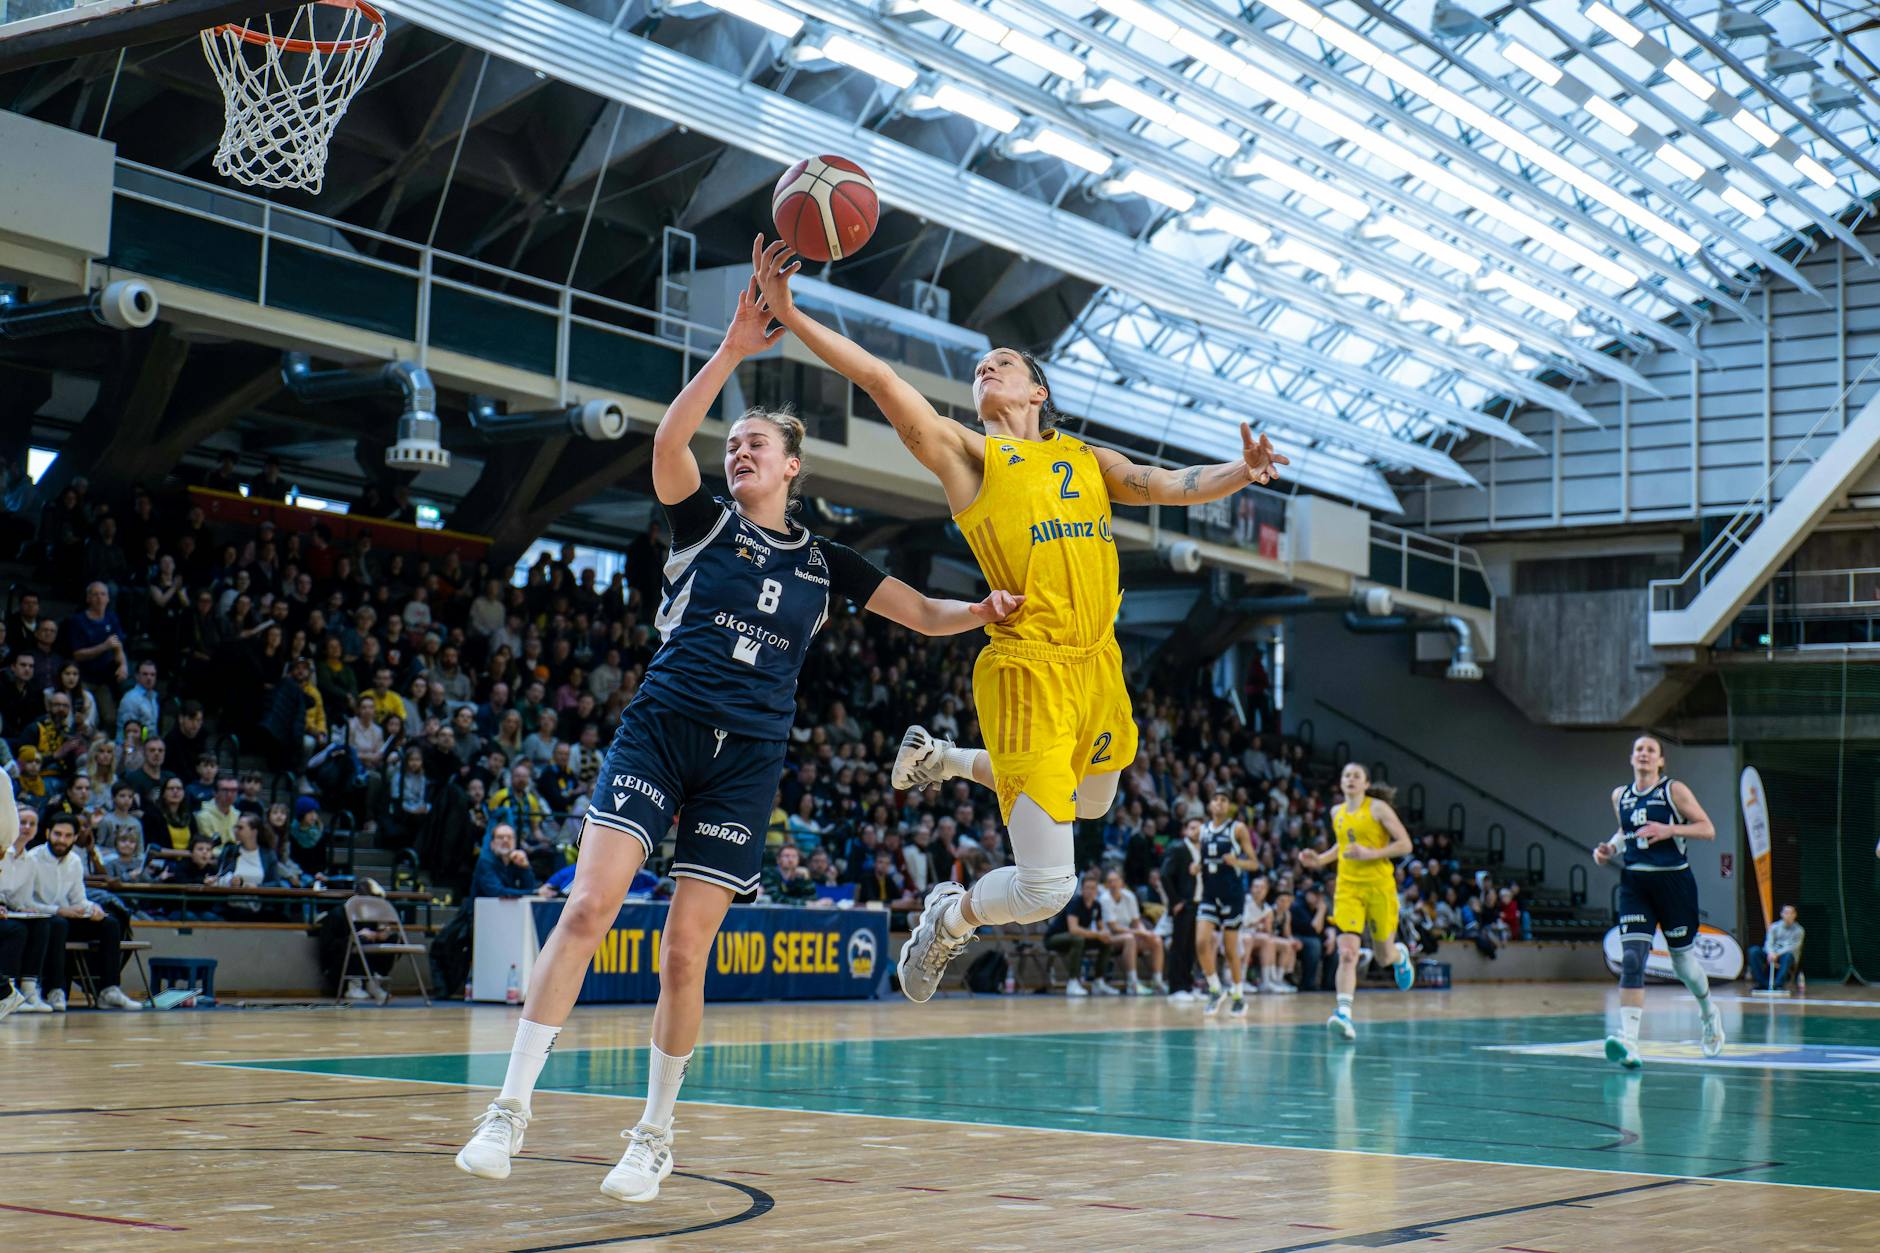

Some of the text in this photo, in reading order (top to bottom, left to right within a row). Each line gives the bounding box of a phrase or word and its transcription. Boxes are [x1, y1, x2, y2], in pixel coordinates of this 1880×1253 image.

[1052, 461, 1080, 499] 2
[735, 533, 771, 556] macron
[1029, 518, 1095, 545] Allianz
[757, 578, 783, 614] 8
[714, 611, 790, 651] ökostrom
[1091, 731, 1112, 764] 2
[612, 774, 665, 810] KEIDEL
[695, 822, 747, 846] JOBRAD
[593, 929, 645, 973] MIT
[716, 931, 766, 975] UND
[772, 929, 840, 974] SEELE
